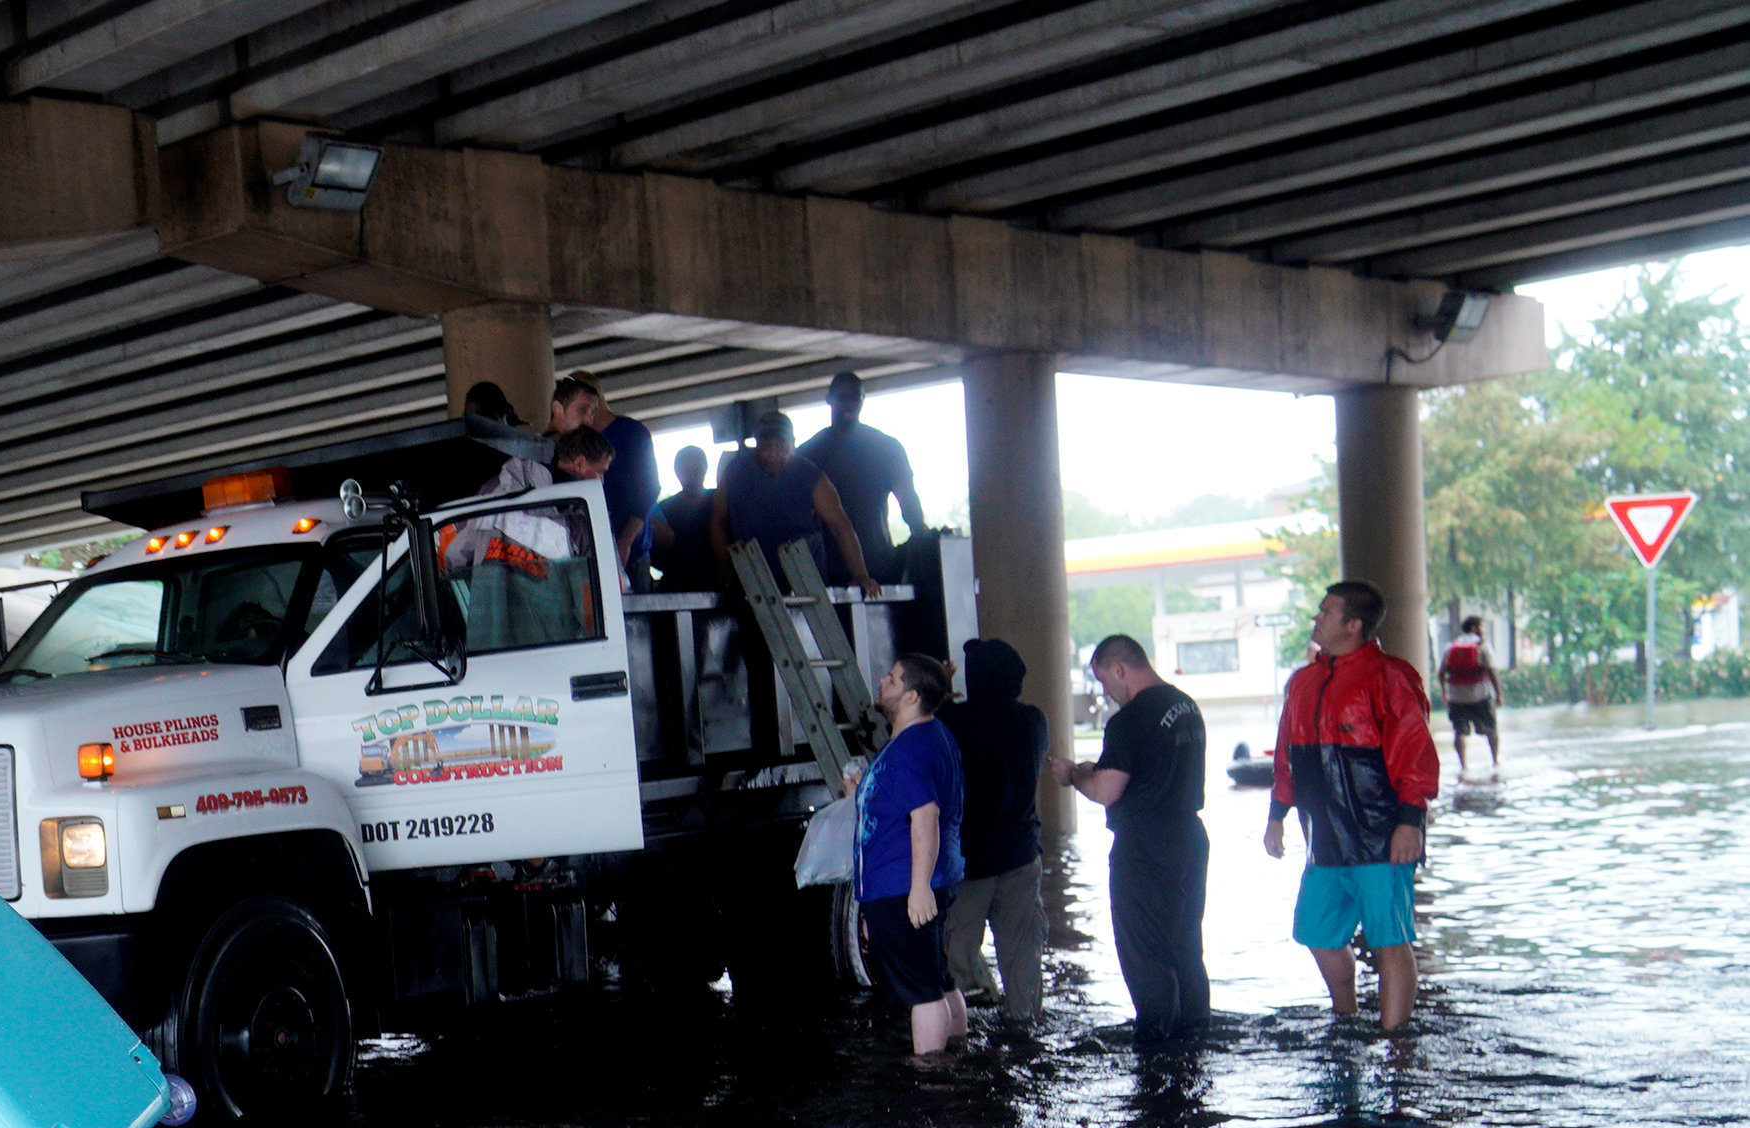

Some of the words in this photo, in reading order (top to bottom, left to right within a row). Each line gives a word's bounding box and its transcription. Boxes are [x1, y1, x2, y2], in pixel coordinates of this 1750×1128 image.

[111, 721, 163, 740] HOUSE
[164, 714, 220, 733] PILINGS
[351, 703, 420, 743] TOP
[423, 695, 560, 725] DOLLAR
[120, 740, 131, 753] &
[133, 728, 220, 751] BULKHEADS
[392, 755, 563, 786] CONSTRUCTION
[360, 822, 400, 843] DOT
[405, 812, 495, 840] 2419228
